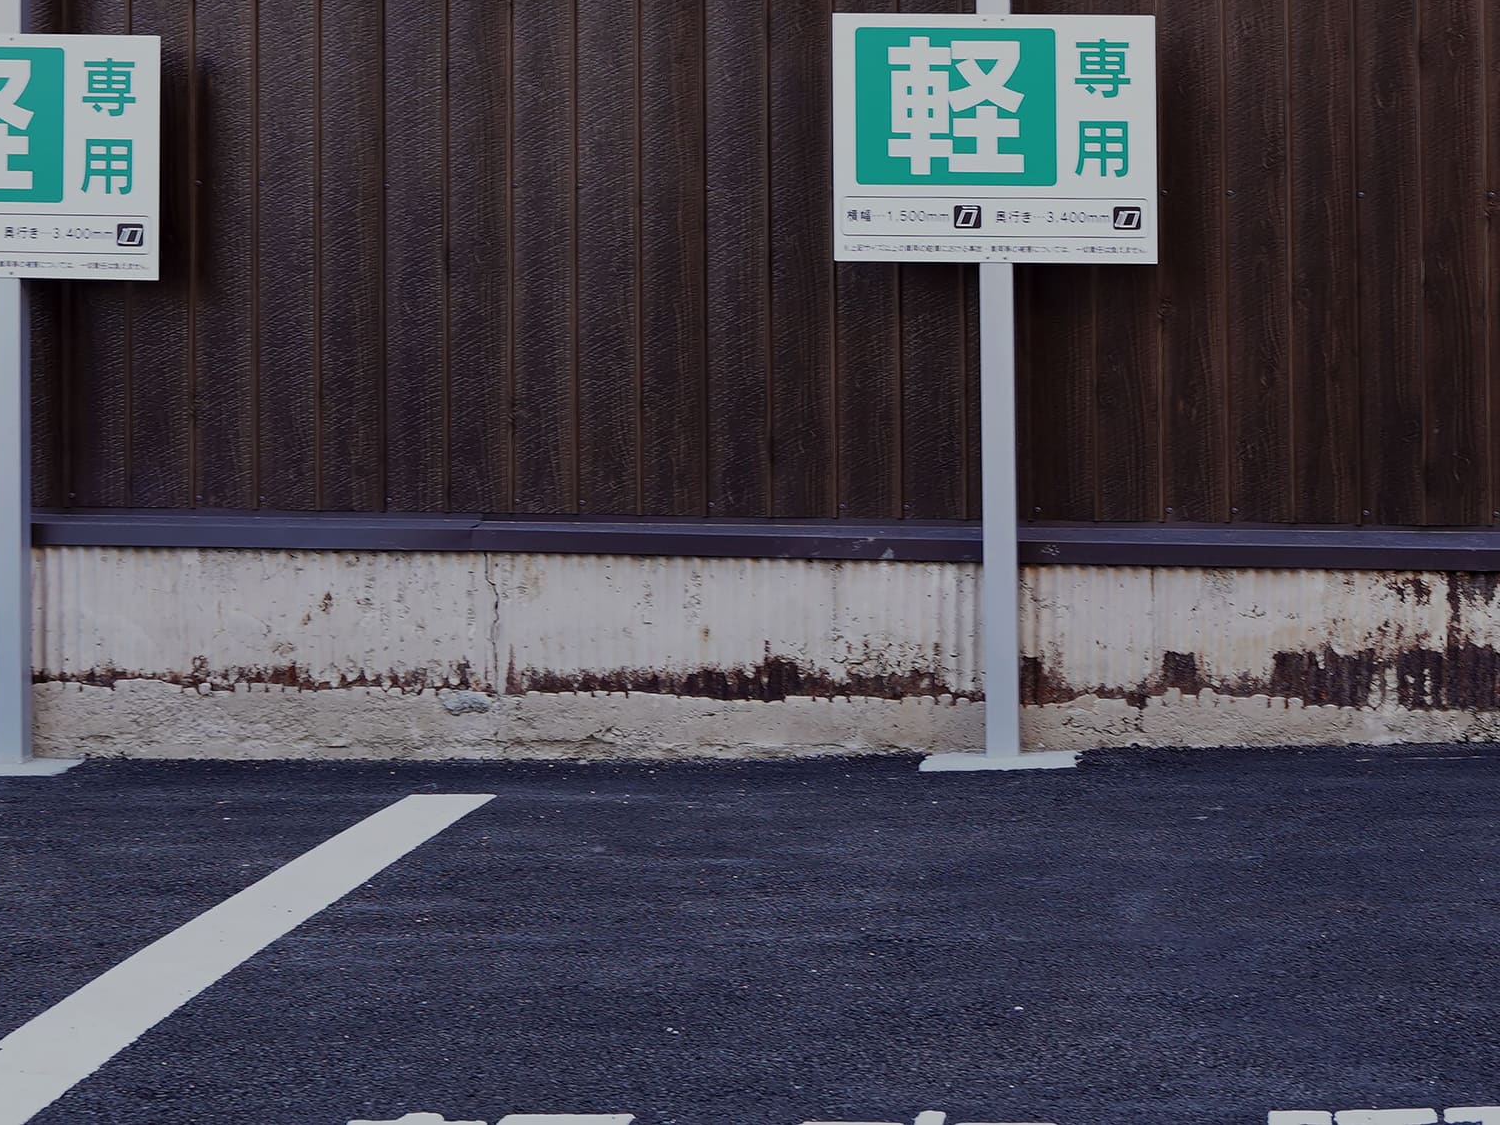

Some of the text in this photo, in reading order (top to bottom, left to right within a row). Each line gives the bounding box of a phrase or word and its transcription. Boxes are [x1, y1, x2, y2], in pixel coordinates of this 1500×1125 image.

[80, 57, 137, 196] 専用
[887, 35, 1132, 179] 軽 専用
